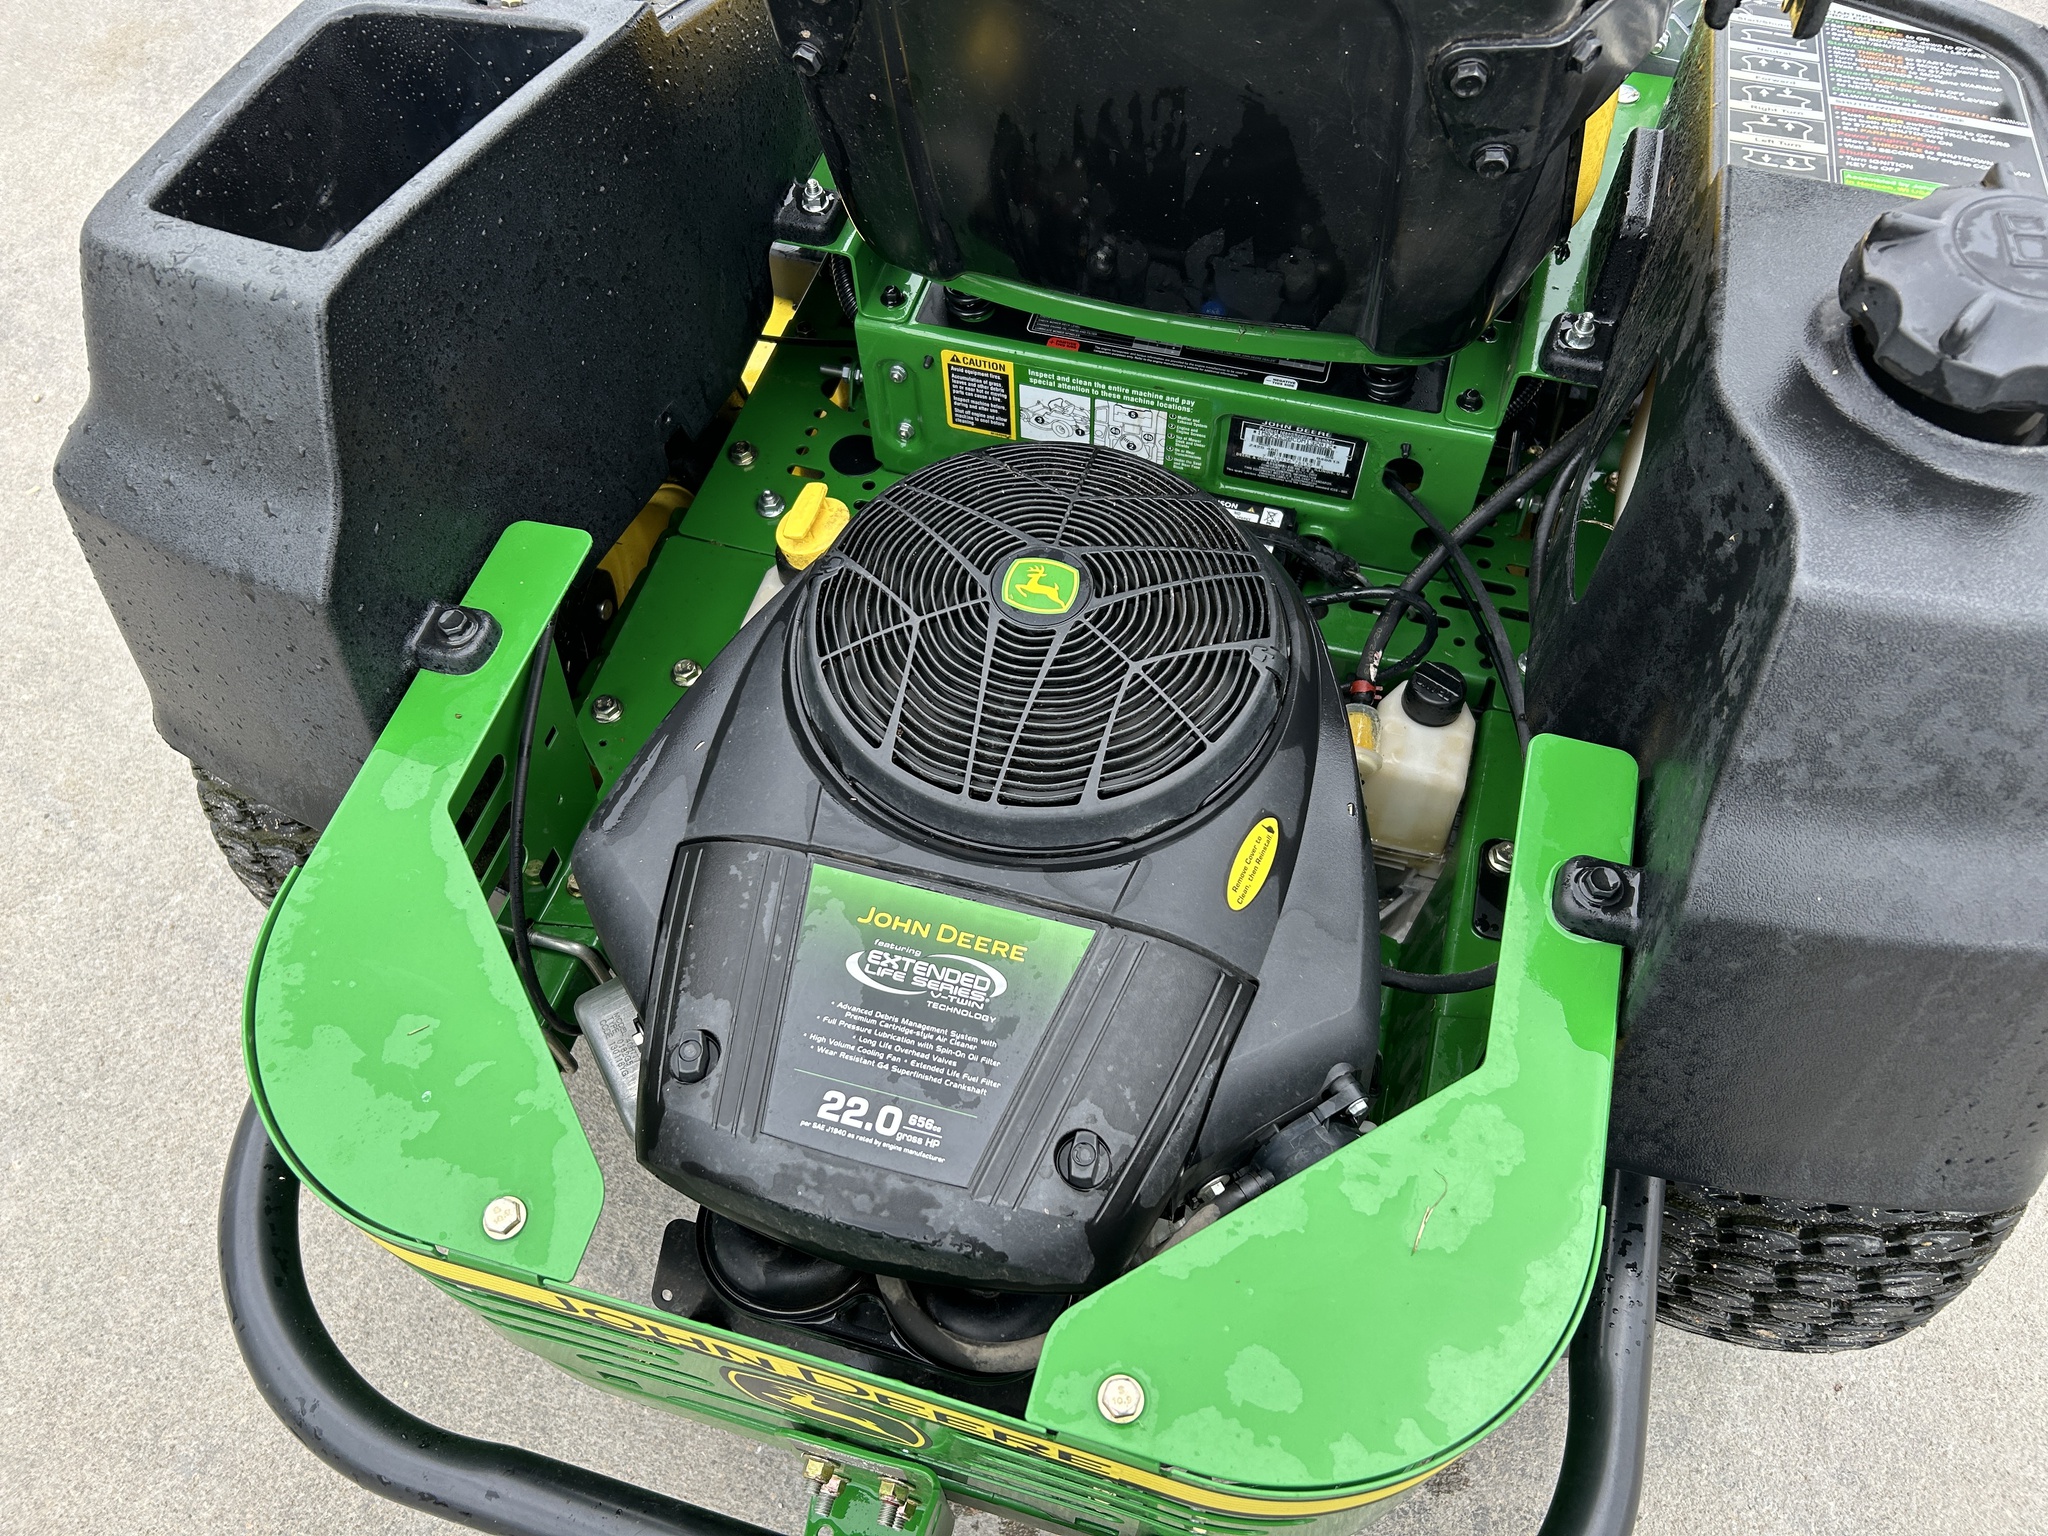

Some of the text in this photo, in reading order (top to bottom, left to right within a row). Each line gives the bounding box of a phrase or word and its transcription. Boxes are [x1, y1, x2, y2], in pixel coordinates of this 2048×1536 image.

[1871, 29, 1902, 37] BRAKE
[1845, 154, 1913, 169] Turn IGNITION
[961, 356, 1005, 372] CAUTION
[964, 368, 989, 377] equipment
[1027, 368, 1054, 379] Inspect
[1071, 377, 1092, 386] clean
[1093, 381, 1106, 389] the
[1107, 384, 1129, 394] entire
[1131, 389, 1163, 400] machine
[1165, 395, 1179, 403] and
[1180, 398, 1195, 407] pay
[1028, 377, 1055, 387] special
[1057, 382, 1090, 393] attention
[1100, 389, 1121, 399] these
[1122, 394, 1154, 405] machine
[1156, 400, 1193, 412] locations:
[1261, 420, 1291, 430] JOHN
[1295, 426, 1330, 437] DEERE
[1231, 835, 1262, 892] Remove Cover to
[1236, 834, 1272, 904] Clean, then Reinstall.
[857, 906, 1027, 961] JOHN DEERE
[874, 938, 921, 957] featuring
[863, 963, 906, 982] LIFE
[867, 949, 990, 991] EXTENDED
[926, 1000, 996, 1023] TECHNOLOGY
[930, 990, 984, 1010] V-TWIN
[822, 1015, 1001, 1067] Full Pressure Lubrication with Spin-On Oil Filter
[836, 1001, 997, 1048] Advanced Debris Management System with
[844, 1011, 977, 1050] Premium Cartridge-style Air Cleaner
[808, 1032, 1001, 1088] High Volume Cooling Fan Extended Life Fuel Filter
[858, 1035, 957, 1066] Long Life Overhead Valves
[816, 1045, 987, 1096] Wear Resistant G4 Superfinished Crankshaft
[817, 1090, 902, 1136] 22.0
[811, 1121, 825, 1131] SAE
[855, 1134, 873, 1144] rated
[873, 1138, 882, 1147] by
[881, 1141, 902, 1151] engine
[902, 1147, 945, 1163] manufacturer
[895, 1131, 940, 1148] gross HP
[538, 1291, 1114, 1474] JOHN DEERE
[1112, 1396, 1132, 1405] 10.9
